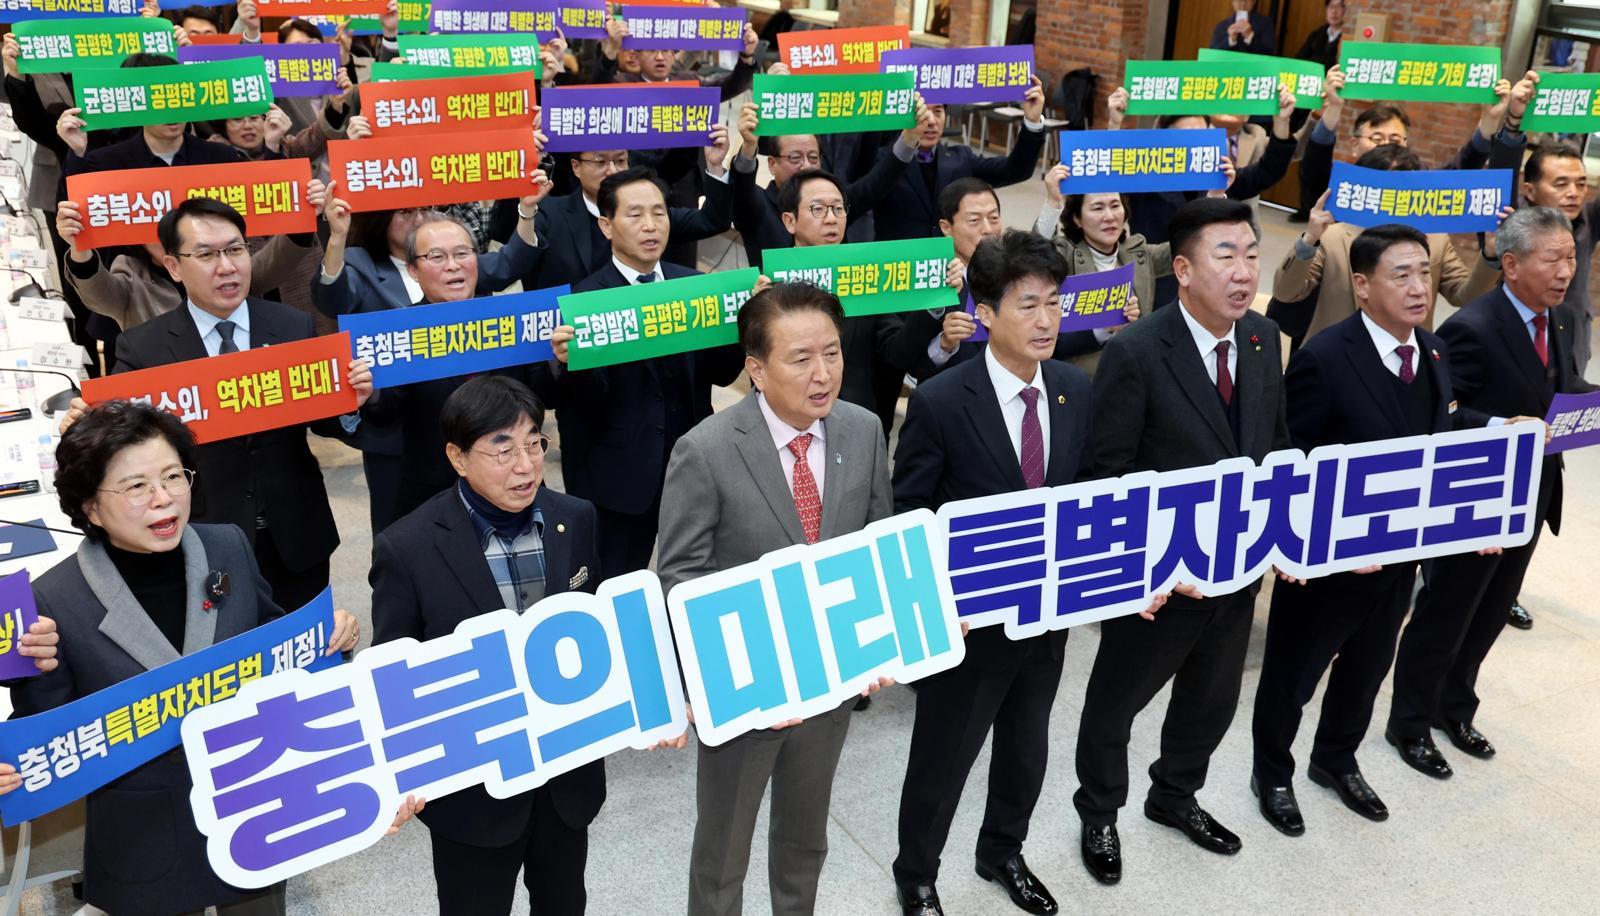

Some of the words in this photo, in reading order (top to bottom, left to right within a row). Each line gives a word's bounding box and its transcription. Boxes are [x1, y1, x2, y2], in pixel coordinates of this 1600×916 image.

[434, 10, 462, 31] 특별한
[463, 10, 488, 31] 희생에
[490, 11, 507, 31] 대한
[509, 11, 533, 31] 특별한
[535, 11, 556, 32] 보상!
[562, 8, 585, 27] 특별한
[587, 9, 605, 28] 보상!
[628, 18, 653, 38] 특별한
[654, 18, 679, 38] 희생에
[680, 19, 697, 38] 대한
[698, 19, 722, 38] 특별한
[723, 20, 743, 39] 보상!
[18, 35, 73, 59] 균형발전
[75, 33, 113, 57] 공평한
[115, 32, 141, 55] 기회
[143, 31, 174, 54] 보장!
[452, 46, 485, 68] 공평한
[487, 47, 509, 67] 기회
[510, 46, 536, 66] 보장!
[789, 44, 838, 69] 충북소외,
[842, 41, 874, 64] 역차별
[278, 58, 310, 83] 특별한
[311, 58, 336, 81] 보상!
[920, 64, 951, 90] 희생에
[954, 63, 974, 88] 대한
[977, 62, 1006, 88] 특별한
[1008, 61, 1030, 87] 보상!
[1297, 74, 1322, 97] 보장!
[1344, 58, 1398, 85] 균형발전
[1398, 60, 1438, 87] 공평한
[1438, 63, 1466, 88] 기회
[1466, 63, 1498, 89] 보장!
[84, 85, 147, 114] 균형발전
[149, 82, 196, 110] 공평한
[199, 79, 229, 105] 기회
[232, 74, 267, 104] 보장!
[760, 92, 814, 119] 균형발전
[816, 90, 856, 118] 공평한
[857, 90, 883, 115] 기회
[885, 88, 914, 115] 보장!
[1130, 76, 1180, 100] 균형발전
[1181, 76, 1219, 100] 공평한
[1220, 76, 1245, 100] 기회
[1246, 76, 1276, 100] 보장!
[1533, 88, 1592, 116] 균형발전
[374, 96, 441, 128] 충북소외,
[447, 92, 490, 121] 역차별
[494, 89, 529, 117] 반대!
[549, 106, 586, 136] 특별한
[588, 106, 623, 135] 희생에
[625, 105, 650, 134] 대한
[651, 105, 683, 133] 특별한
[686, 105, 714, 132] 보상!
[345, 157, 424, 193] 충북소외,
[430, 152, 482, 185] 역차별
[486, 149, 526, 181] 반대!
[1071, 147, 1188, 177] 충청북특별자치도법
[1190, 145, 1221, 174] 제정!
[252, 181, 300, 215] 반대!
[1336, 181, 1467, 217] 충청북특별자치도법
[1468, 187, 1502, 216] 제정!
[836, 263, 880, 297] 공평한
[882, 260, 911, 292] 기회
[914, 258, 948, 290] 보장!
[1074, 288, 1108, 316] 특별한
[1106, 281, 1131, 312] 보상!
[573, 308, 640, 349] 균형발전
[641, 300, 688, 338] 공평한
[690, 295, 720, 329] 기회
[356, 315, 516, 368] 충청북특별자치도법
[216, 369, 284, 414] 역차별
[288, 358, 340, 401] 반대!
[1552, 409, 1584, 438] 특별한
[0, 608, 24, 655] 상!
[202, 587, 672, 872] 충북의
[684, 524, 950, 729] 미래
[948, 433, 1535, 626] 특별자치도로!
[18, 651, 262, 793] 충청북특별자치도법
[270, 620, 326, 675] 제정!
